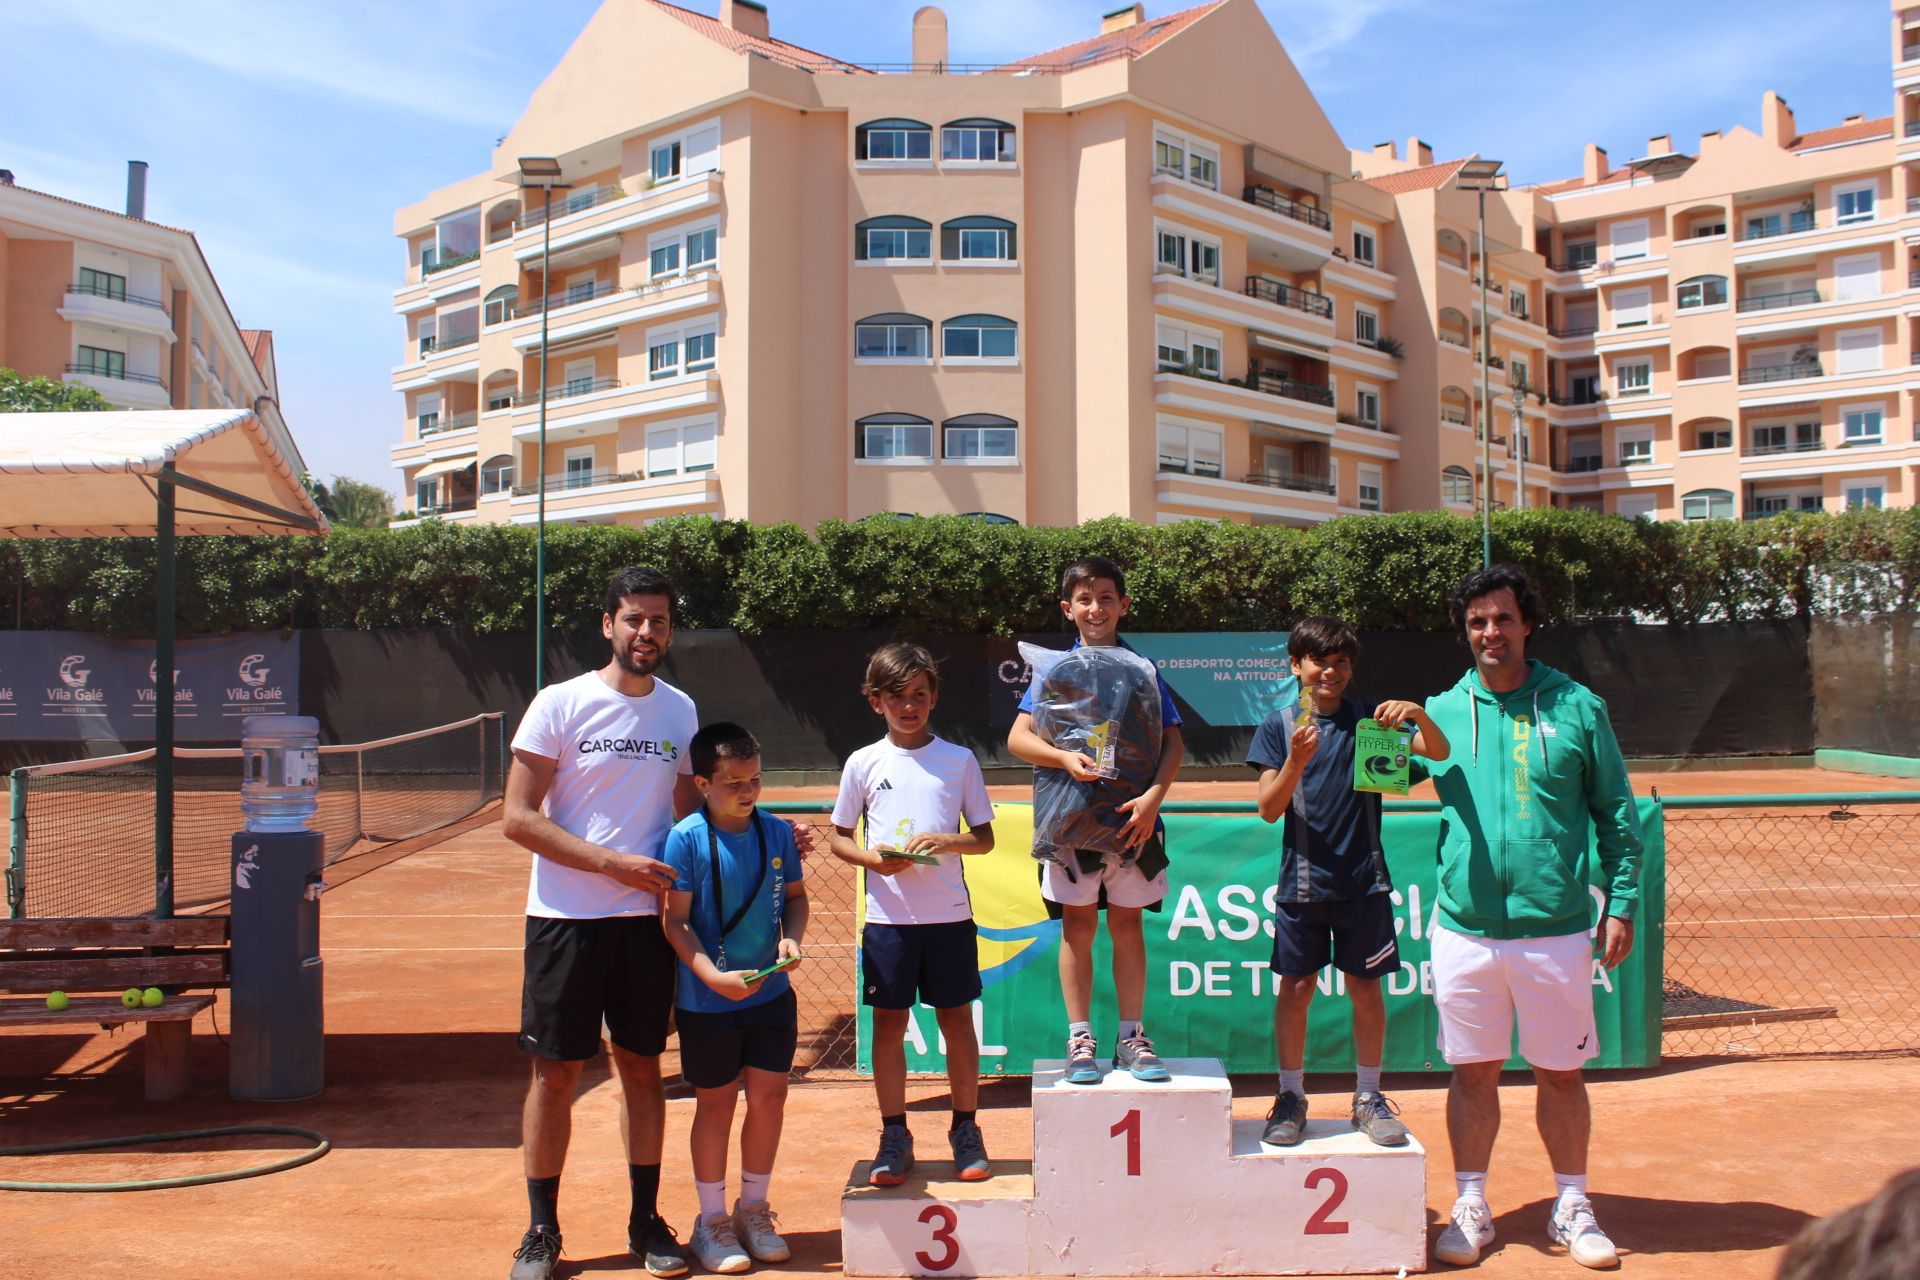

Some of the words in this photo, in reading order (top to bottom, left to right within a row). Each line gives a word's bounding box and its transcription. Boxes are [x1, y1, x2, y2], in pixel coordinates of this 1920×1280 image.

[1157, 659, 1166, 669] O
[1170, 659, 1233, 669] DESPORTO
[1237, 658, 1288, 670] COMEÇA
[1214, 671, 1232, 681] NA
[1234, 671, 1288, 681] ATITUDE!
[46, 688, 71, 701] Vila
[74, 688, 104, 701] Galé
[174, 689, 193, 701] alé
[226, 688, 250, 701] Vila
[254, 686, 282, 700] Galé
[1358, 738, 1406, 752] HYPER-G
[772, 875, 783, 924] CADEMY
[1170, 961, 1232, 996] DE
[1110, 1109, 1142, 1177] 1
[1303, 1167, 1349, 1235] 2
[914, 1204, 961, 1272] 3
